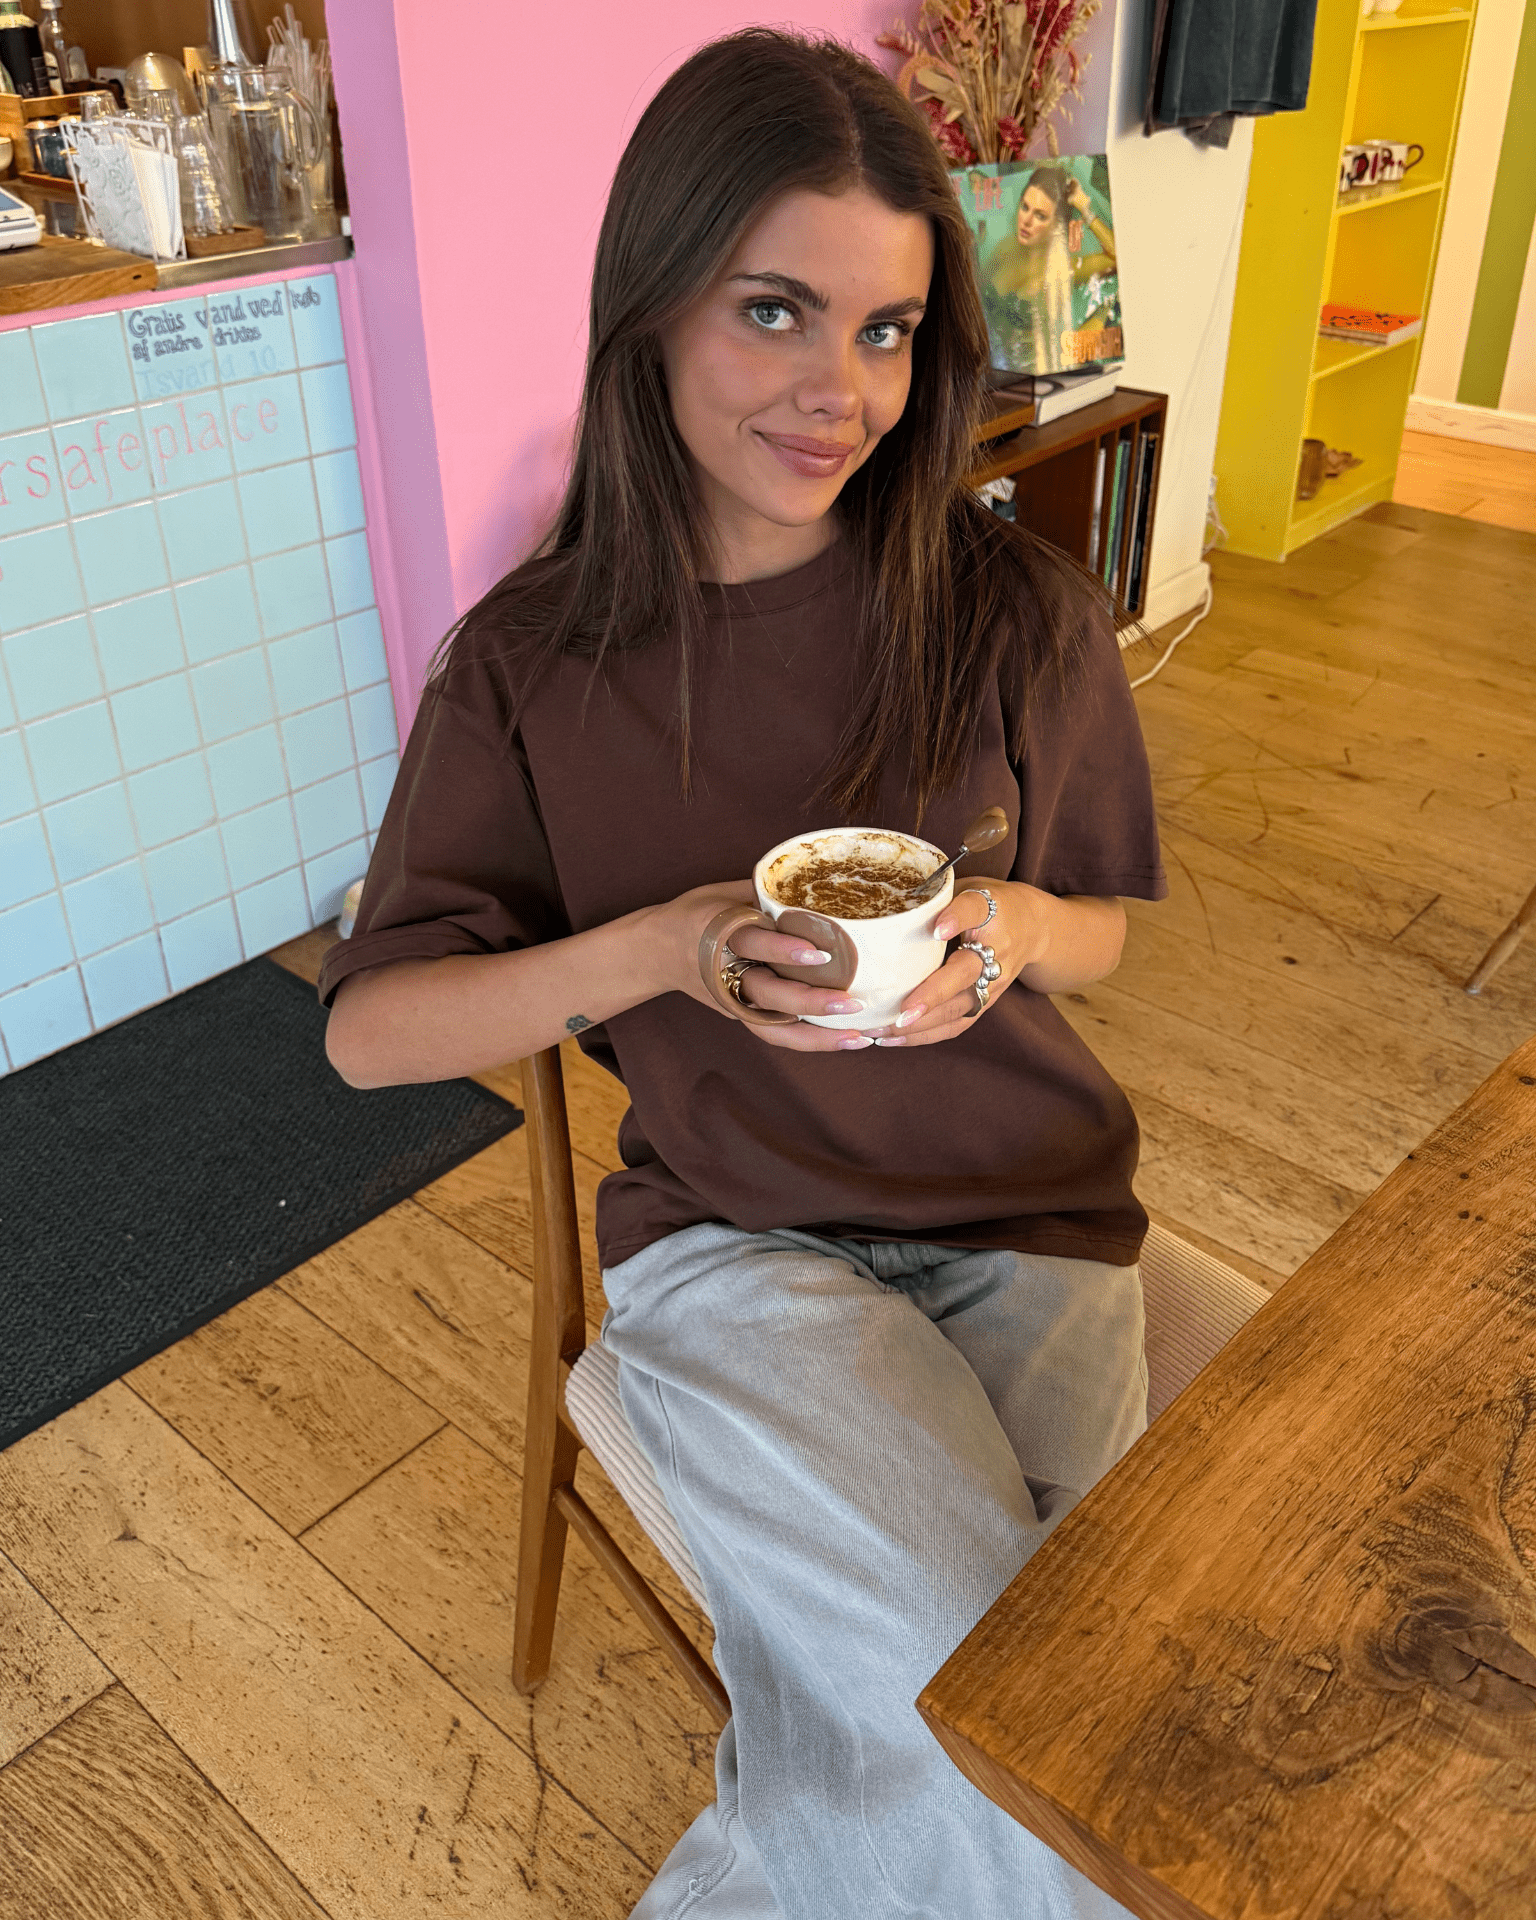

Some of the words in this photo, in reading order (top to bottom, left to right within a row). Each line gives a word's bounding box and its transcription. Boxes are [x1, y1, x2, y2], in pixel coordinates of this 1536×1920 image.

[128, 309, 187, 338] Gratis
[194, 295, 247, 329] vand
[246, 290, 284, 318] ved
[131, 338, 151, 362] af
[154, 334, 203, 357] andre
